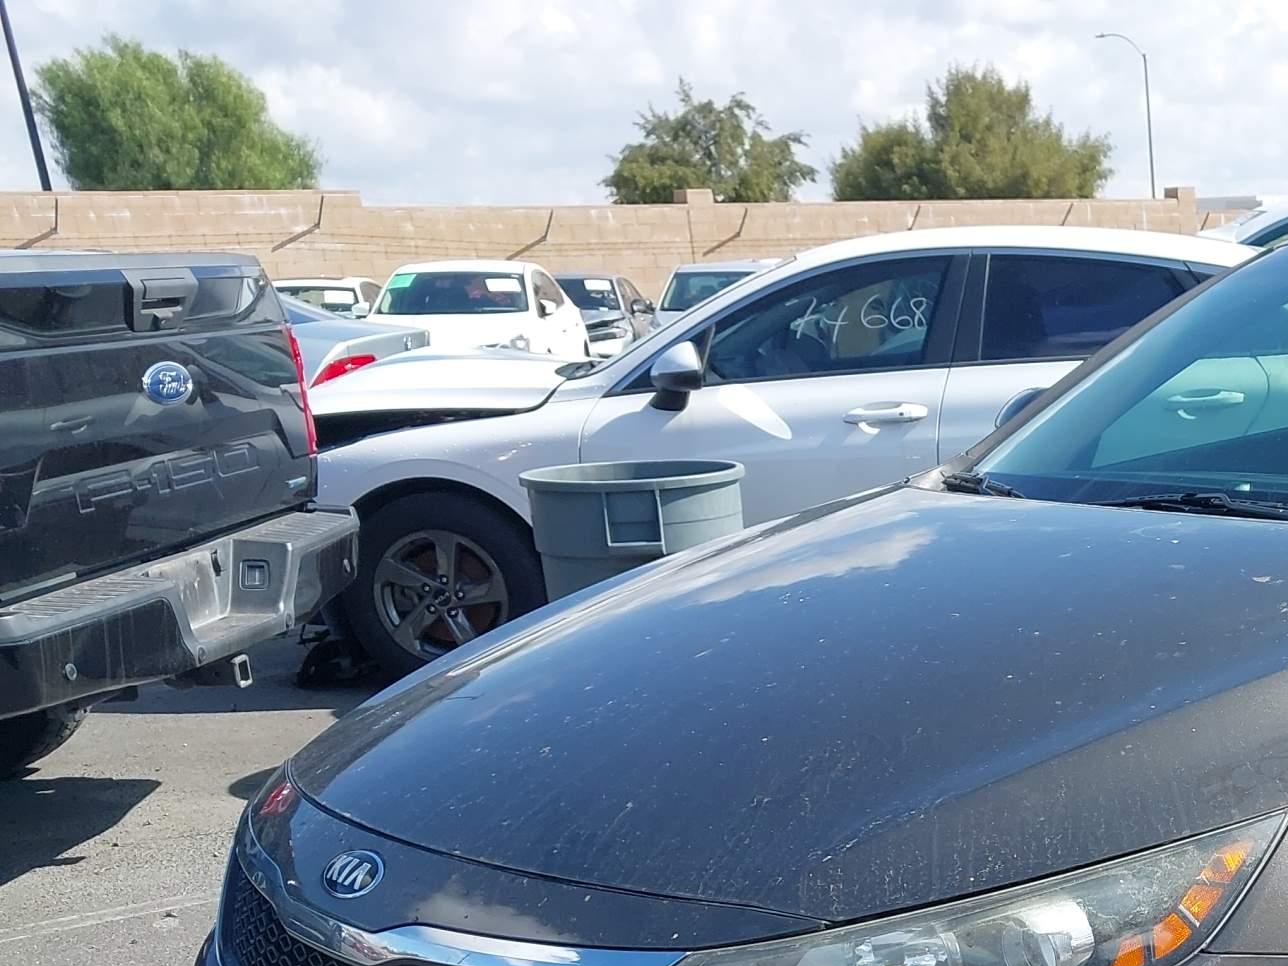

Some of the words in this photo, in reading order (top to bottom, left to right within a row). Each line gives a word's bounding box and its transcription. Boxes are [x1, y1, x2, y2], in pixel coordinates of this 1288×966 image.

[159, 371, 187, 395] Ford
[75, 441, 260, 513] F-150
[326, 854, 372, 891] KIA
